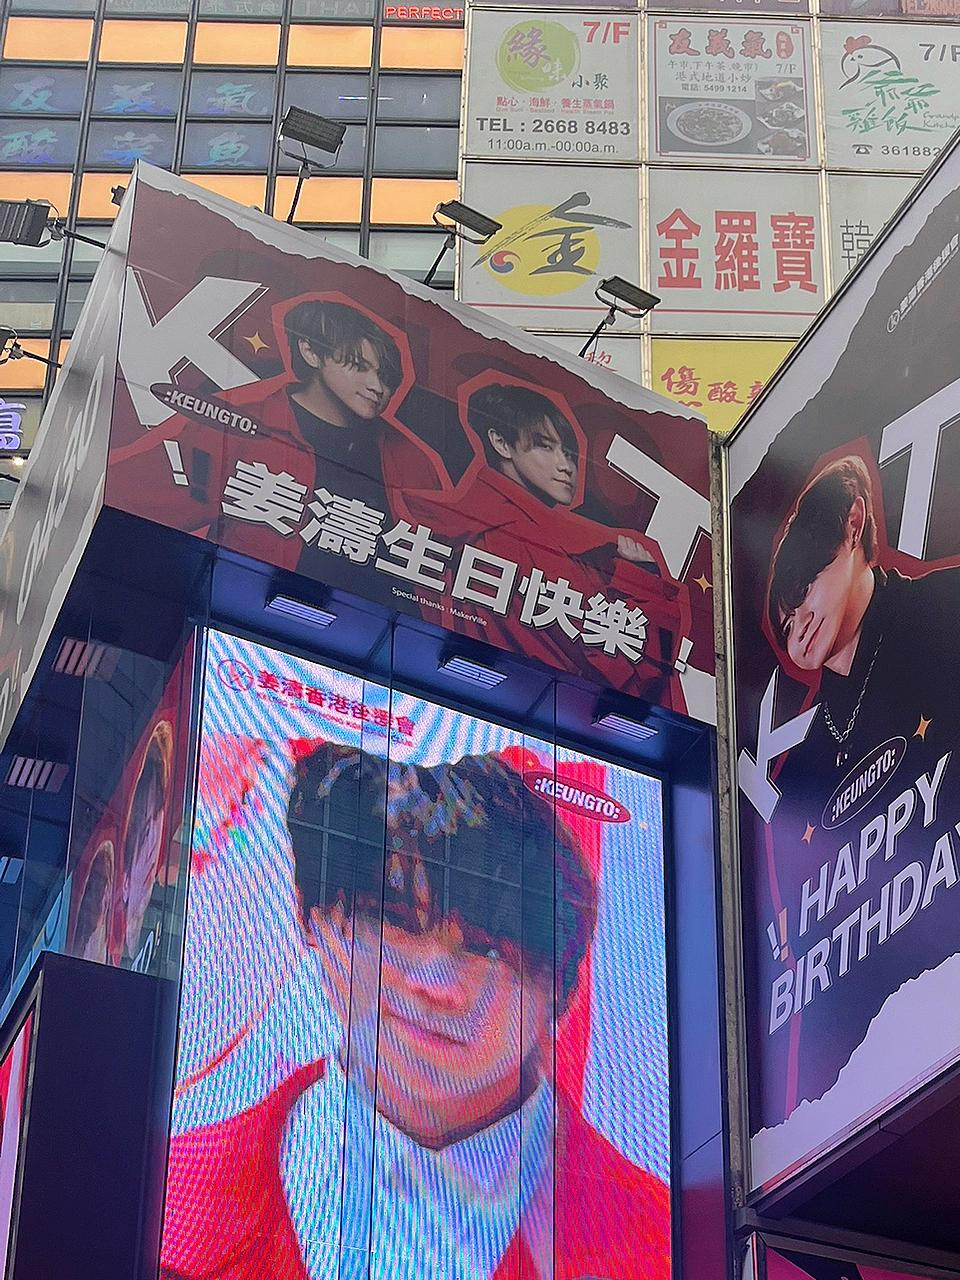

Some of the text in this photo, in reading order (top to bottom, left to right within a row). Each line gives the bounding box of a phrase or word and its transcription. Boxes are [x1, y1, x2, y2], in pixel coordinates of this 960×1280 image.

[385, 6, 464, 20] PERFECT
[583, 21, 631, 44] 7/F
[532, 119, 578, 133] 2668
[585, 121, 631, 135] 8483
[656, 208, 818, 294] 金羅寶
[221, 459, 651, 665] 姜濤生日快樂
[799, 750, 953, 938] HAPPY
